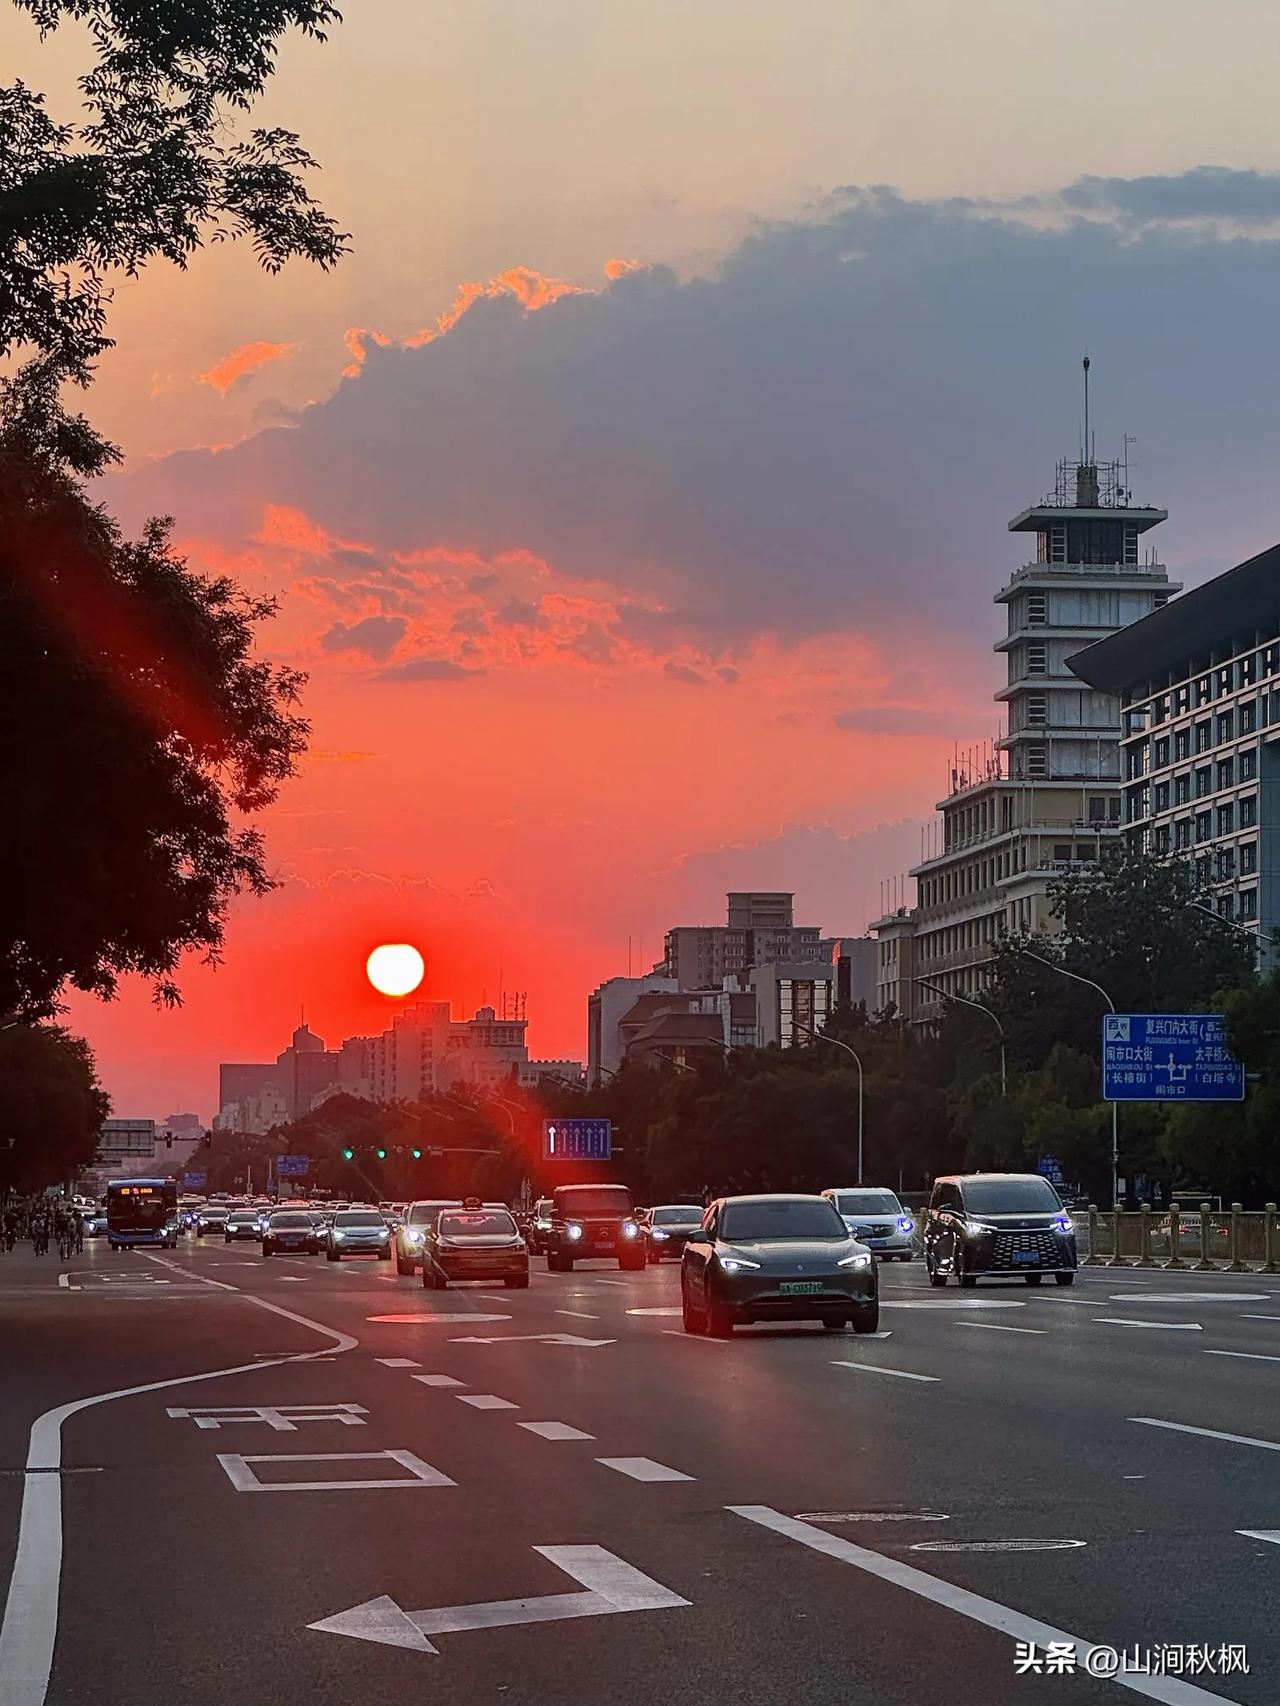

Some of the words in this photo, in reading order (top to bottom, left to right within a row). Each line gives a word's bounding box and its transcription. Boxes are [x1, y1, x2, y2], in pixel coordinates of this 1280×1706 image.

[1108, 1018, 1119, 1030] 西
[1145, 1018, 1198, 1035] 复兴门内大街
[1106, 1046, 1153, 1061] 闹市口大街
[1195, 1046, 1234, 1062] 太平桥大
